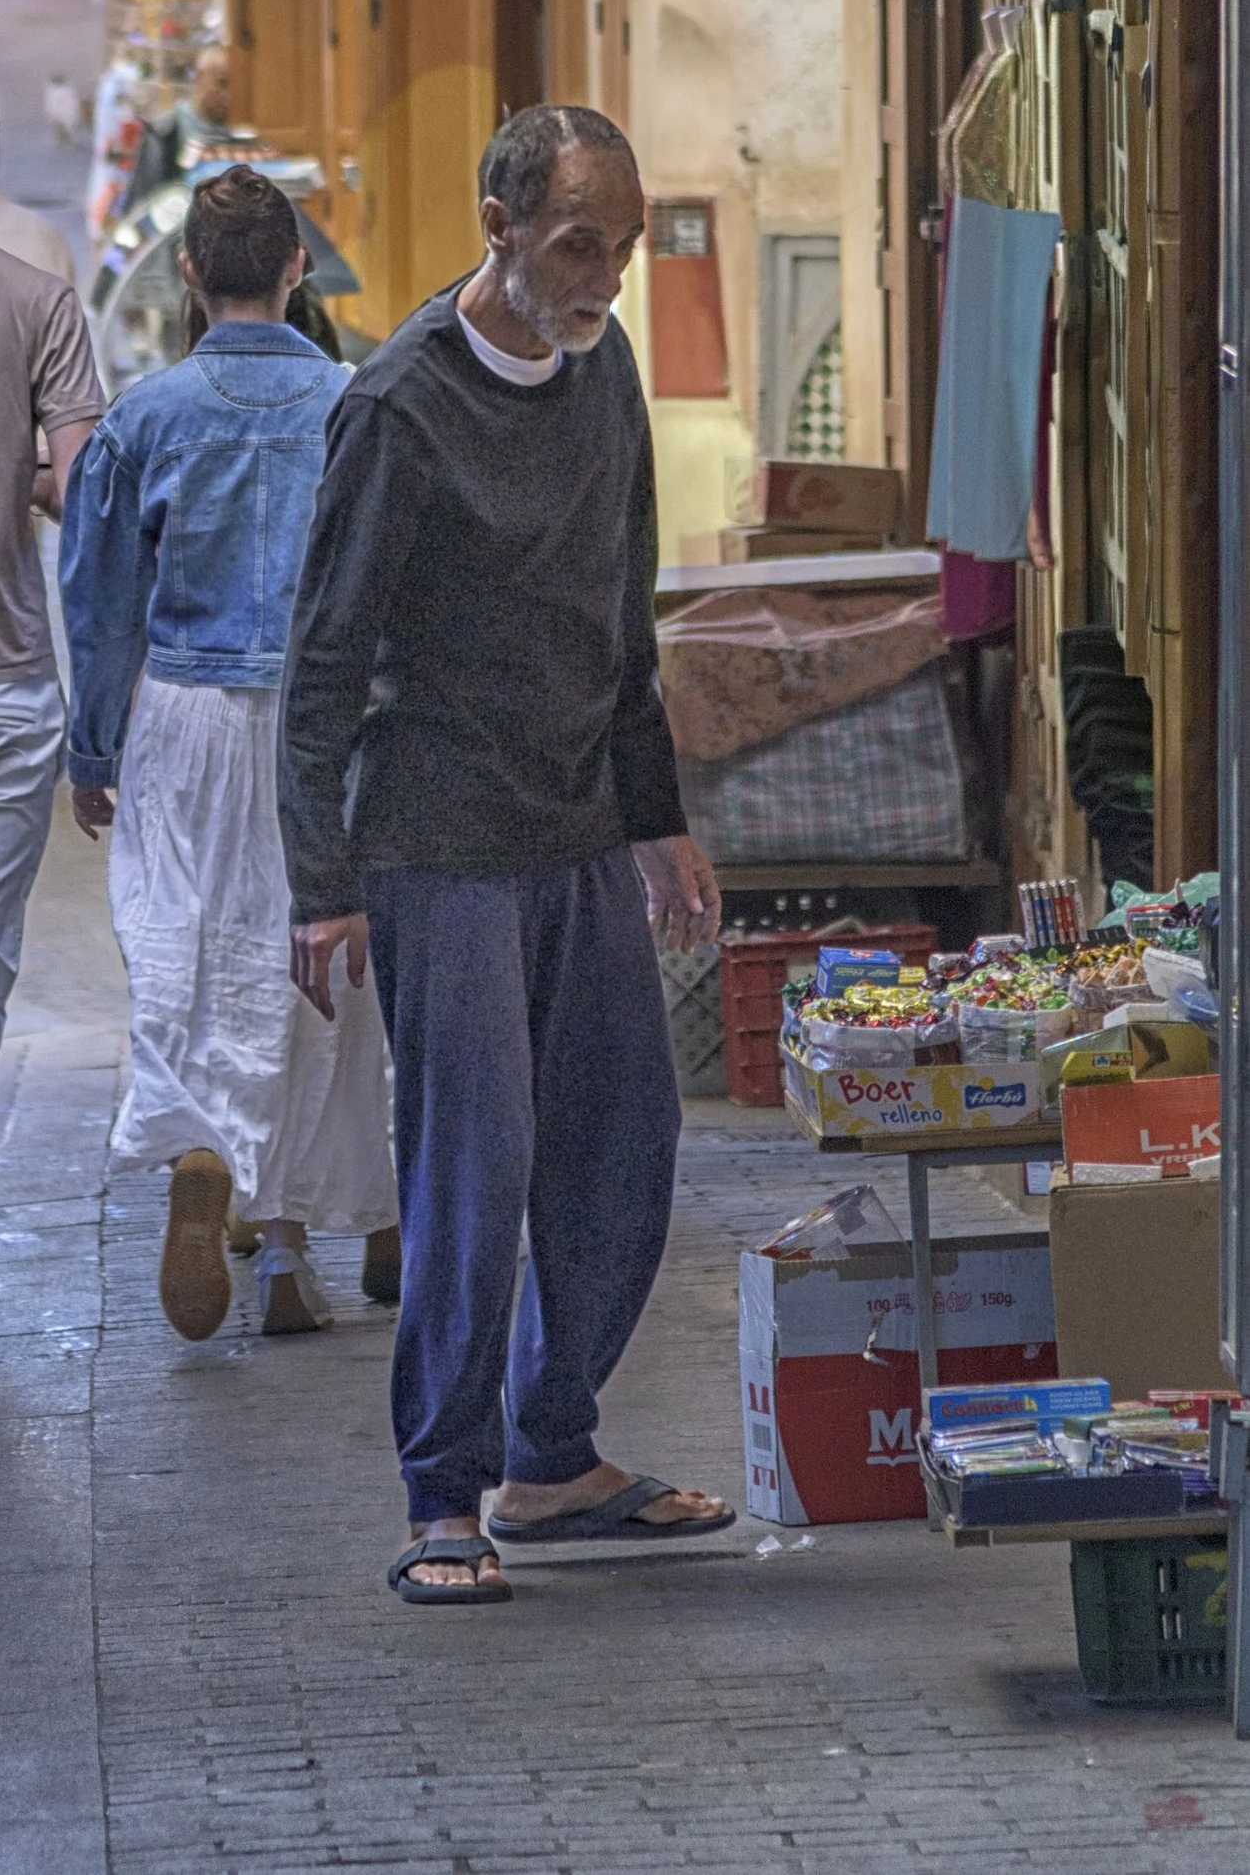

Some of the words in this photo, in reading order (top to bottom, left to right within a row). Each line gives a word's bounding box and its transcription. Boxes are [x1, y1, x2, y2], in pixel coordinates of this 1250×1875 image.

[838, 1074, 915, 1104] Boer
[880, 1105, 942, 1124] relleno
[941, 1398, 1021, 1418] Connect
